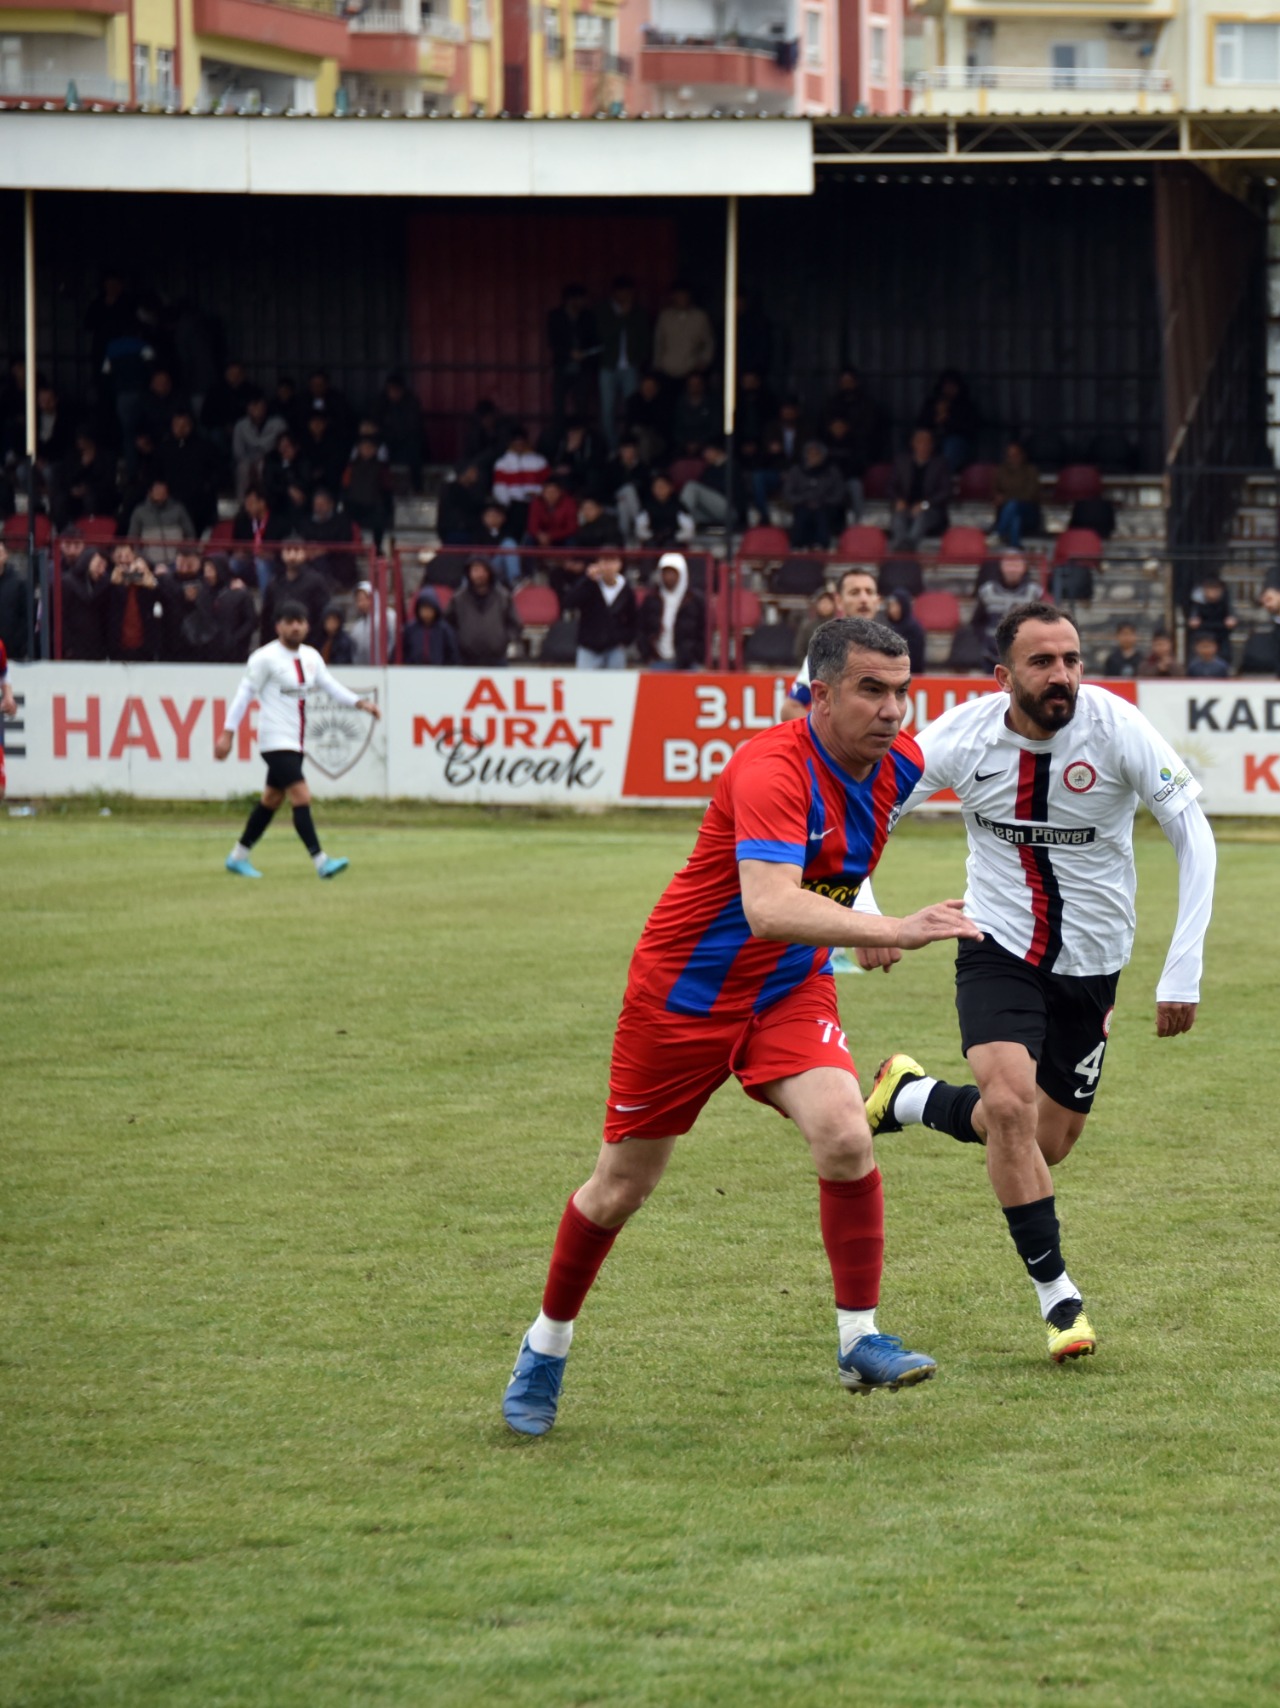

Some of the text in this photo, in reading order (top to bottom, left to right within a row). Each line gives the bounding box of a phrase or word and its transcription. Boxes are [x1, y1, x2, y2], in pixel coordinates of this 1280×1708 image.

[464, 677, 565, 713] ALİ
[412, 715, 614, 749] MURAT
[435, 730, 604, 789] Bucak
[1031, 826, 1090, 844] Power
[1074, 1041, 1105, 1085] 4
